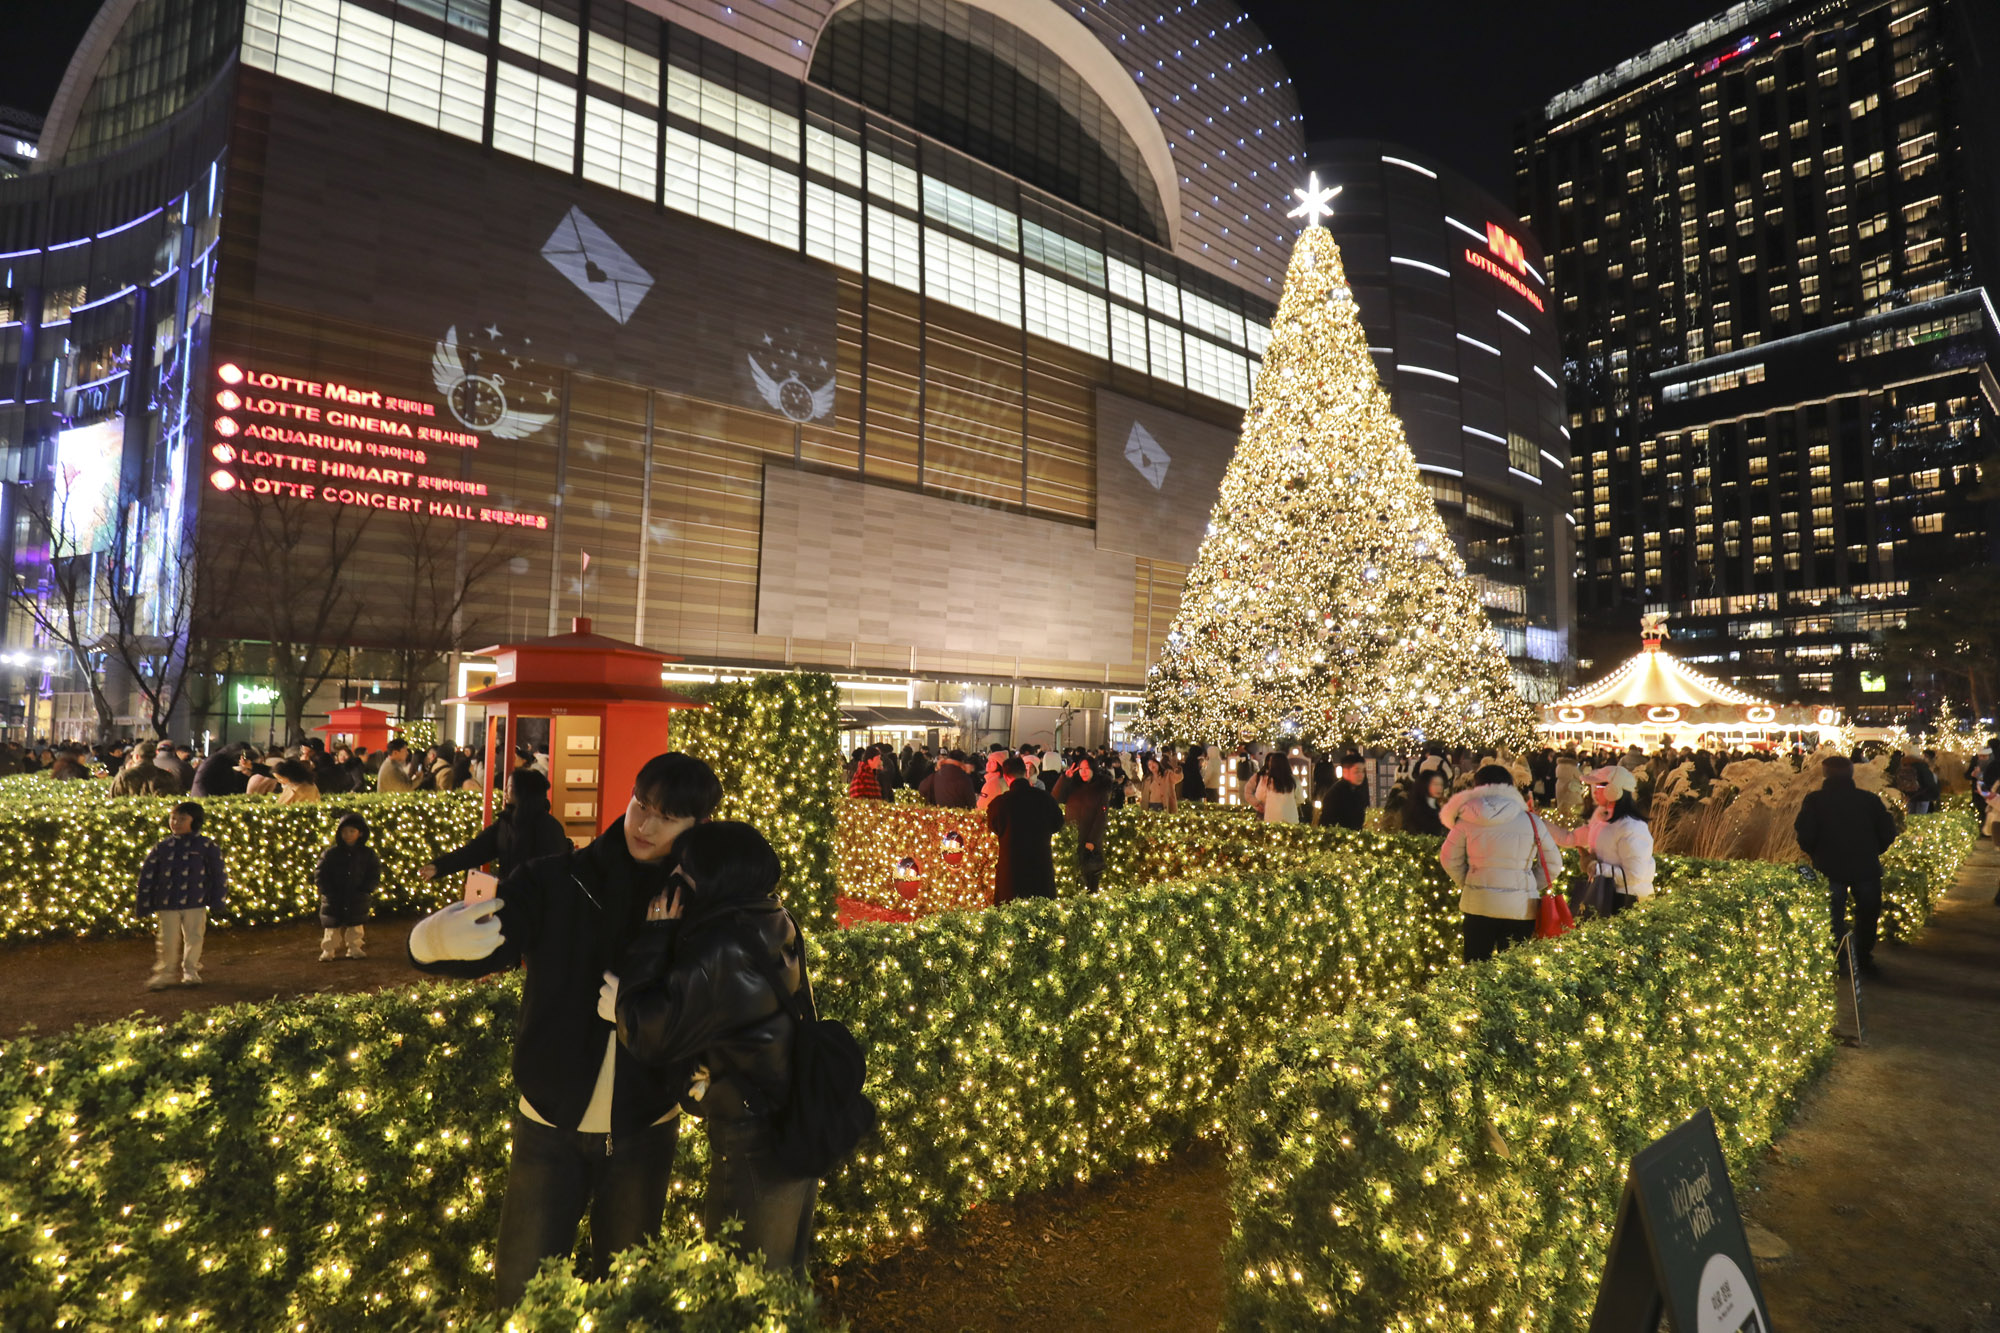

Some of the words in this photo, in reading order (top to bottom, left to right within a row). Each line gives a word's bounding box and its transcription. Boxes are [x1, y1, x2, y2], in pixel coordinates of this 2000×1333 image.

[1465, 249, 1498, 277] LOTTE
[1498, 267, 1527, 297] WORLD
[246, 370, 322, 397] LOTTE
[325, 382, 381, 408] Mart
[244, 424, 362, 455] AQUARIUM
[365, 443, 427, 465] 아쿠아리움
[245, 397, 321, 422] LOTTE
[326, 411, 413, 438] CINEMA
[417, 426, 479, 449] 롯데시네마
[241, 449, 317, 473] LOTTE
[321, 460, 414, 486] HIMART
[417, 475, 489, 497] 롯데하이마트
[322, 487, 421, 513] CONCERT
[429, 501, 476, 521] HALL
[479, 508, 548, 530] 롯데콘서트홀
